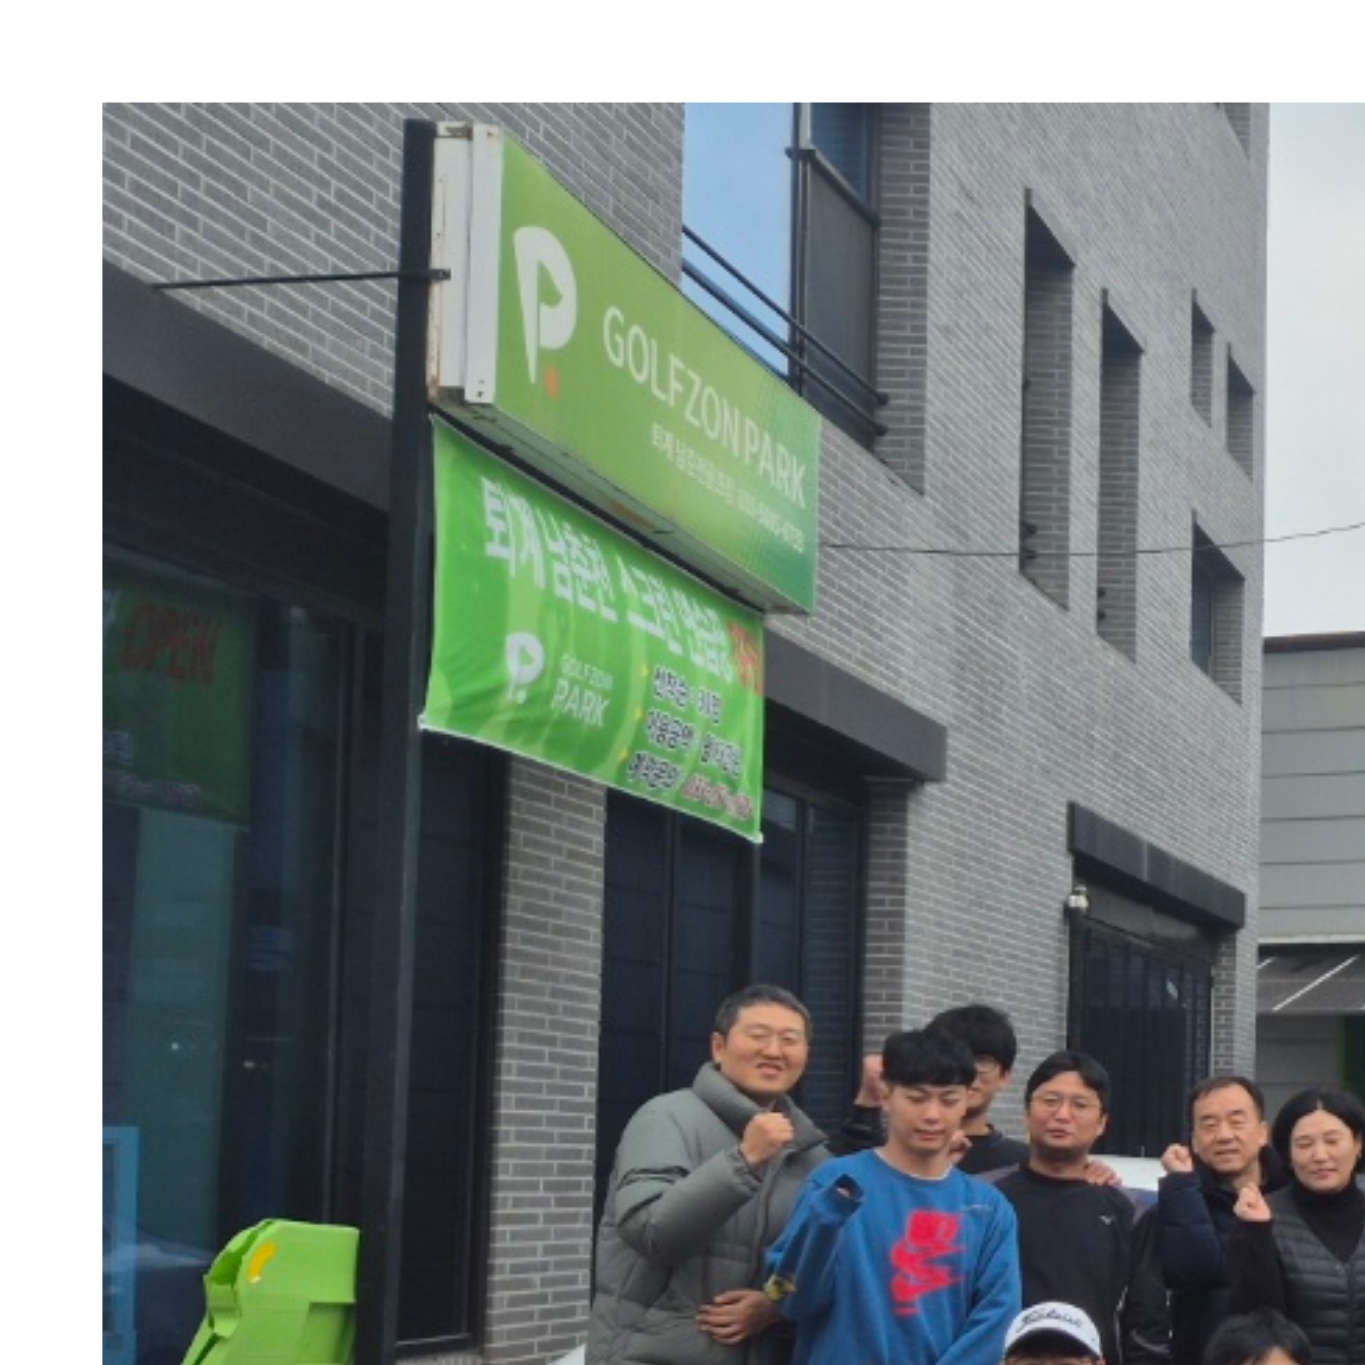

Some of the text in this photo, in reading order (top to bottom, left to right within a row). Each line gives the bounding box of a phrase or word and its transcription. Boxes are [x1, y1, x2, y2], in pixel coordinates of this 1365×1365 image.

[603, 306, 739, 457] GOLFZON
[744, 418, 806, 509] PARK
[550, 679, 611, 728] PARK
